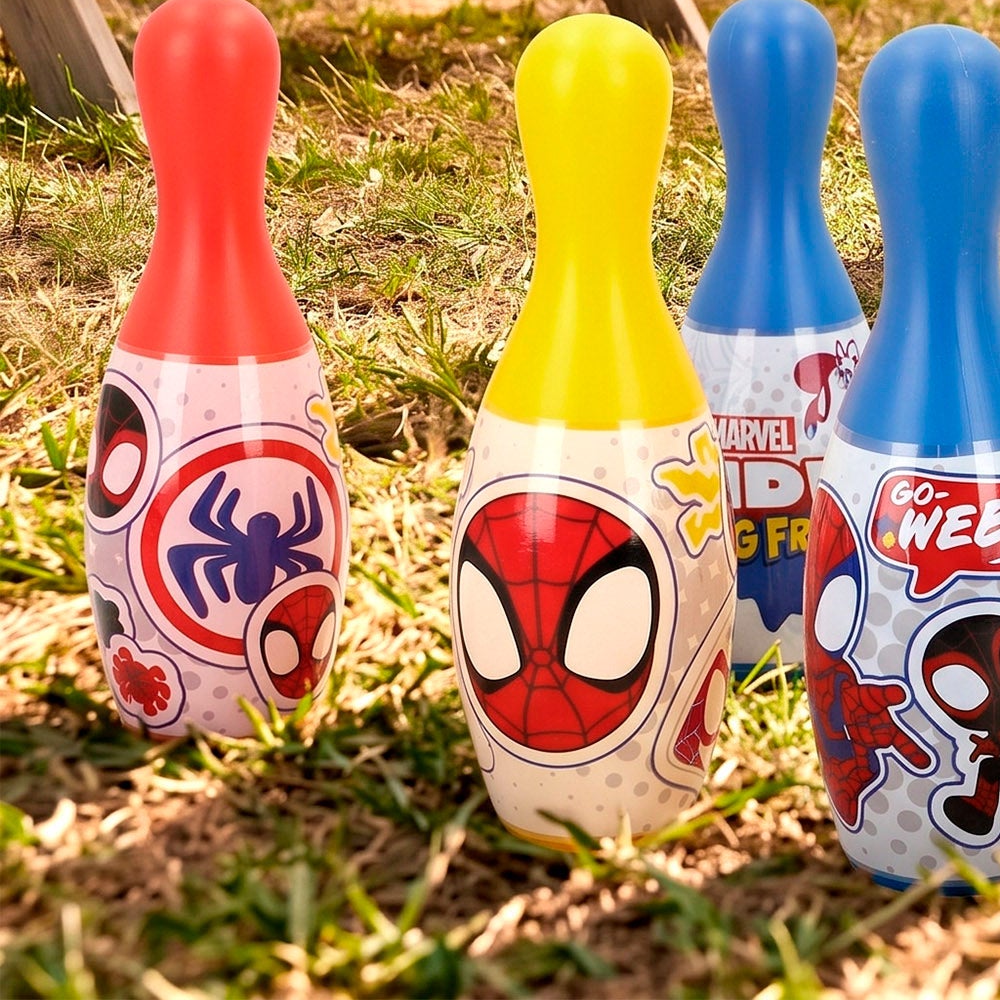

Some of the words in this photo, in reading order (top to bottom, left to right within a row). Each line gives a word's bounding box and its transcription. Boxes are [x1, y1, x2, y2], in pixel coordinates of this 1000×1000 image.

[890, 480, 950, 506] GO-
[735, 518, 759, 560] G
[766, 516, 811, 559] FR
